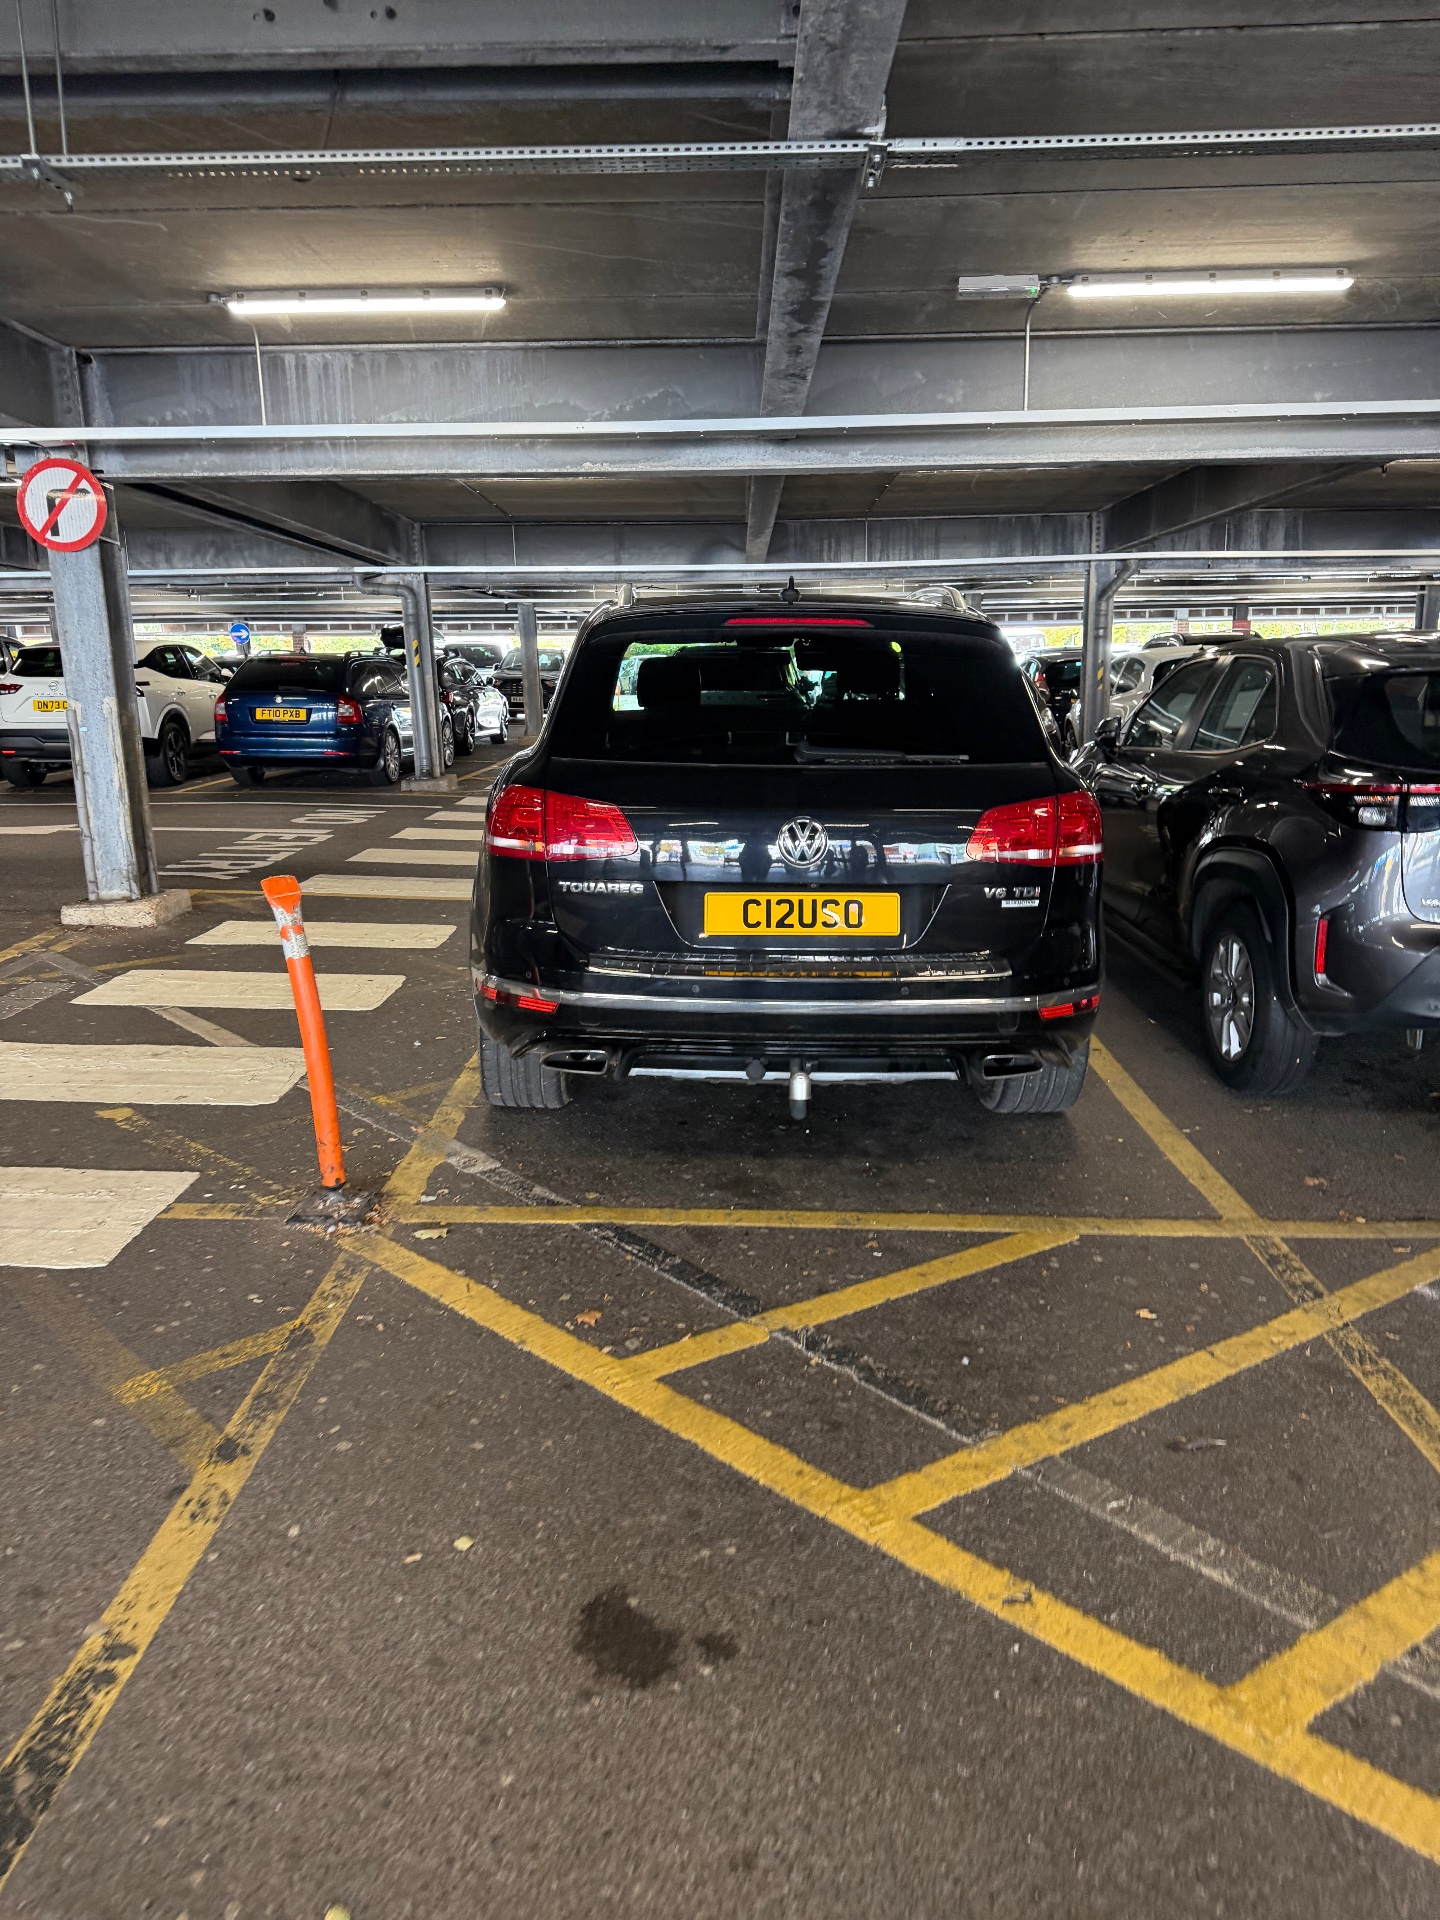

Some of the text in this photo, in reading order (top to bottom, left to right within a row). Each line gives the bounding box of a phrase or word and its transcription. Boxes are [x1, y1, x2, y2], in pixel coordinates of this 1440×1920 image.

[37, 700, 60, 710] DN73
[261, 709, 301, 719] FT10 PXB
[157, 809, 387, 880] NO ENTRY
[559, 881, 644, 894] TOUAREG
[984, 886, 1041, 899] V6 TDI
[742, 898, 864, 929] C12USO
